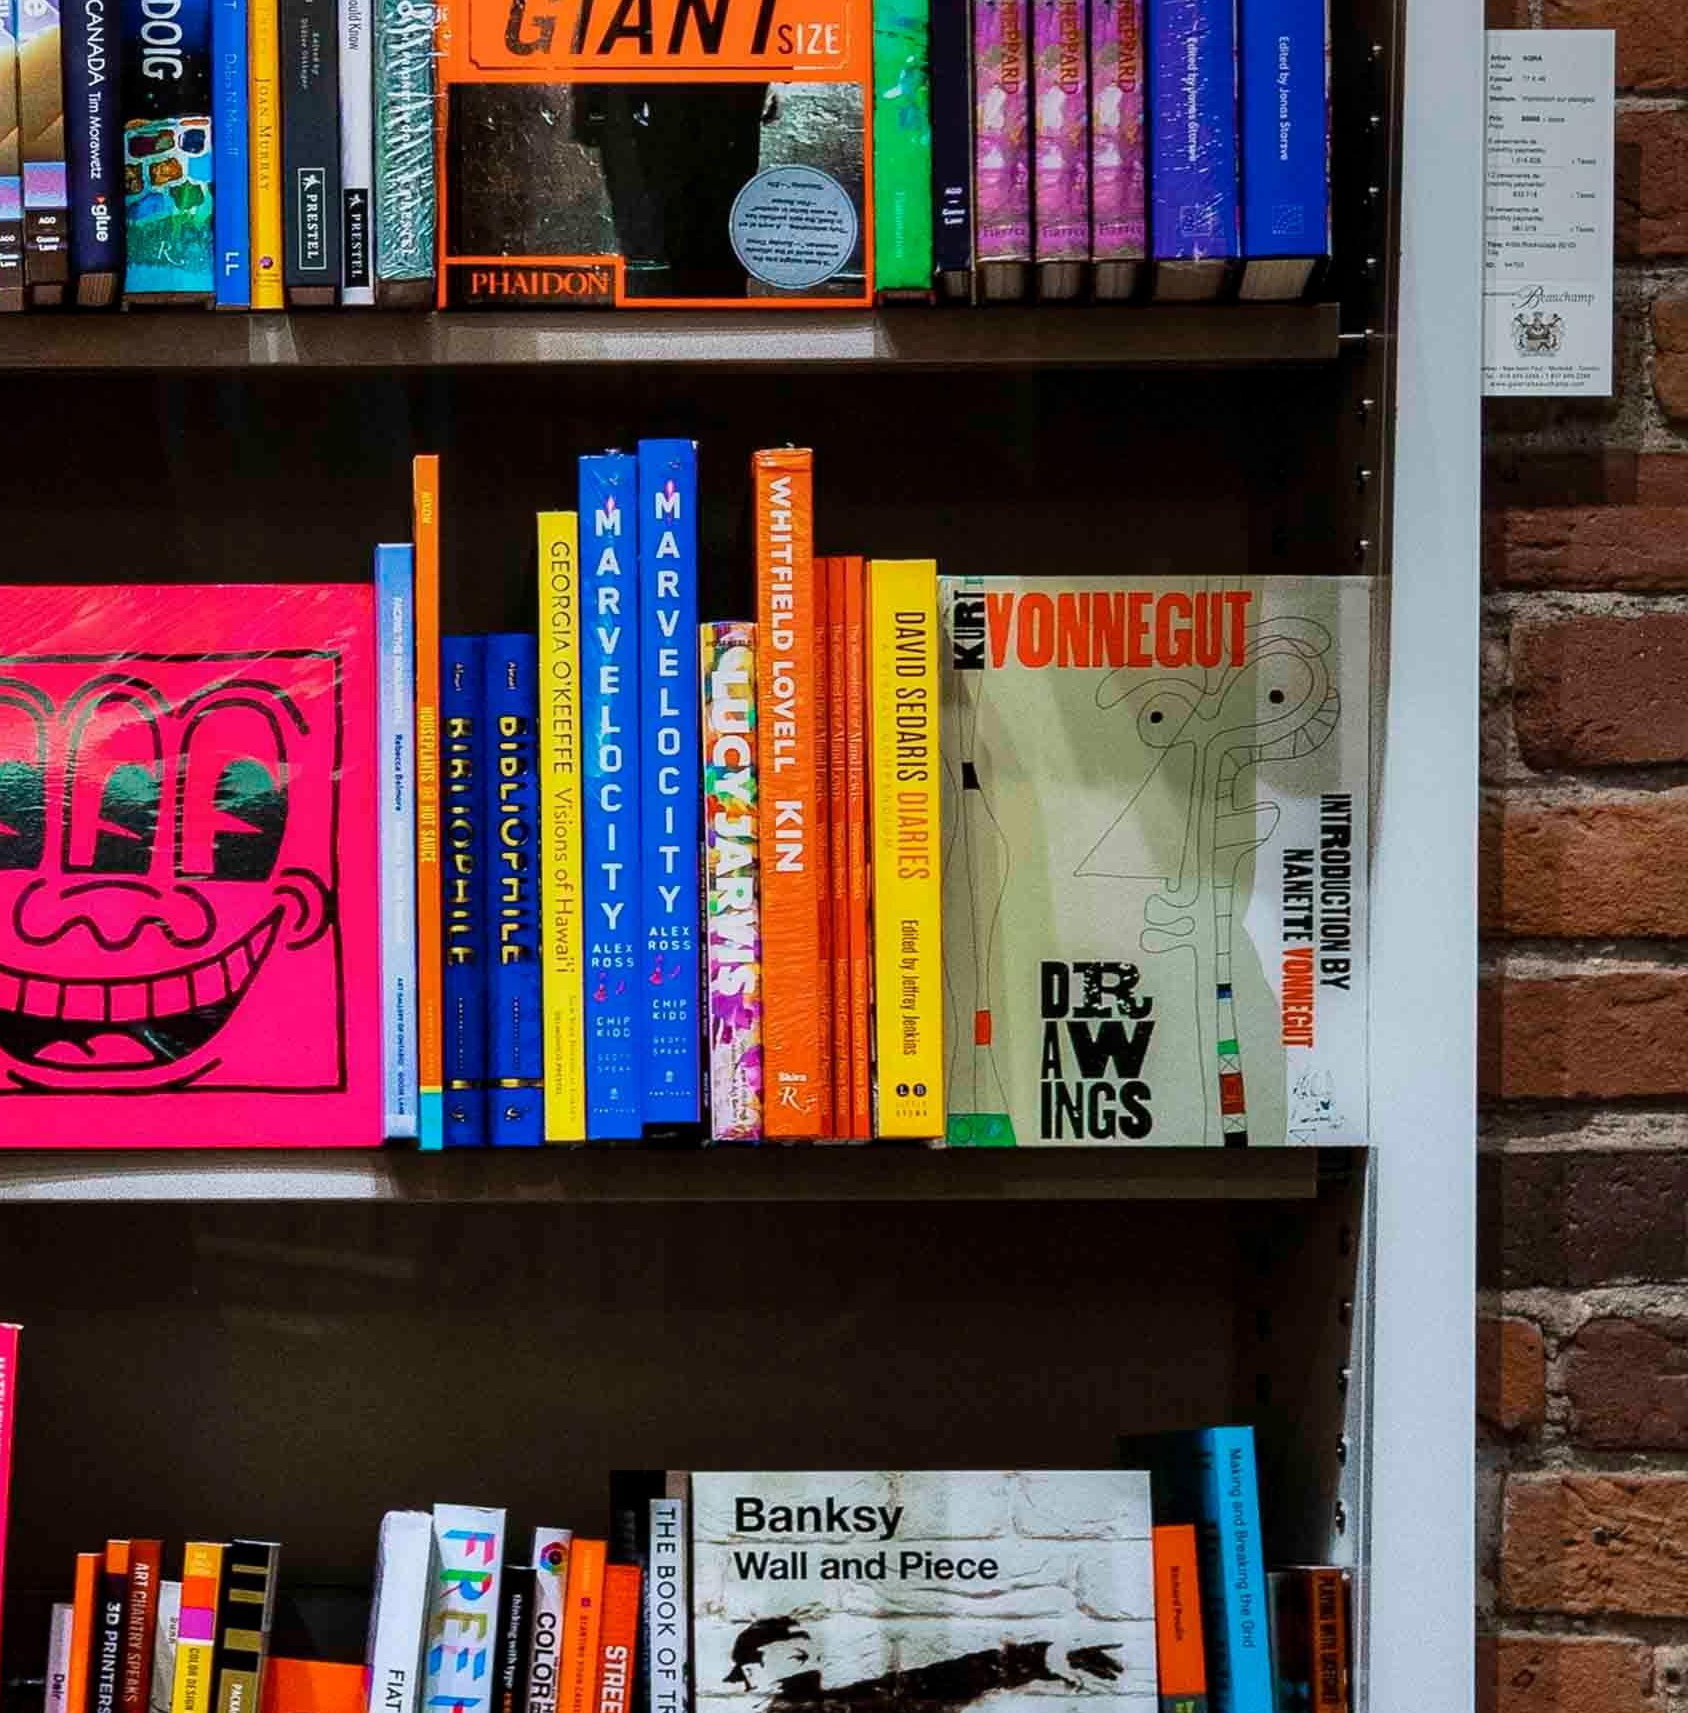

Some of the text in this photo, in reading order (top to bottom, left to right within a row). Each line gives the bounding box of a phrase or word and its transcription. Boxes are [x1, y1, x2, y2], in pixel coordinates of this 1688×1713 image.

[778, 24, 843, 58] SIZE
[472, 272, 609, 296] PHAIDON
[985, 590, 1254, 671] VONNEGUT
[656, 492, 681, 913] MARVELOCITY
[770, 476, 805, 873] WHITFIELD LOVELL KIN
[895, 611, 930, 880] DAVID SEDARIS DIARIES
[1320, 794, 1351, 990] INTRODUCTION BY
[1282, 848, 1315, 1049] NANETTE VONNEGUT
[657, 1508, 675, 1553] THE
[733, 1497, 904, 1538] Banksy
[733, 1551, 999, 1581] Wall and Piece
[657, 1565, 675, 1638] BOOK
[384, 1669, 405, 1713] FIAT
[657, 1647, 676, 1678] OF
